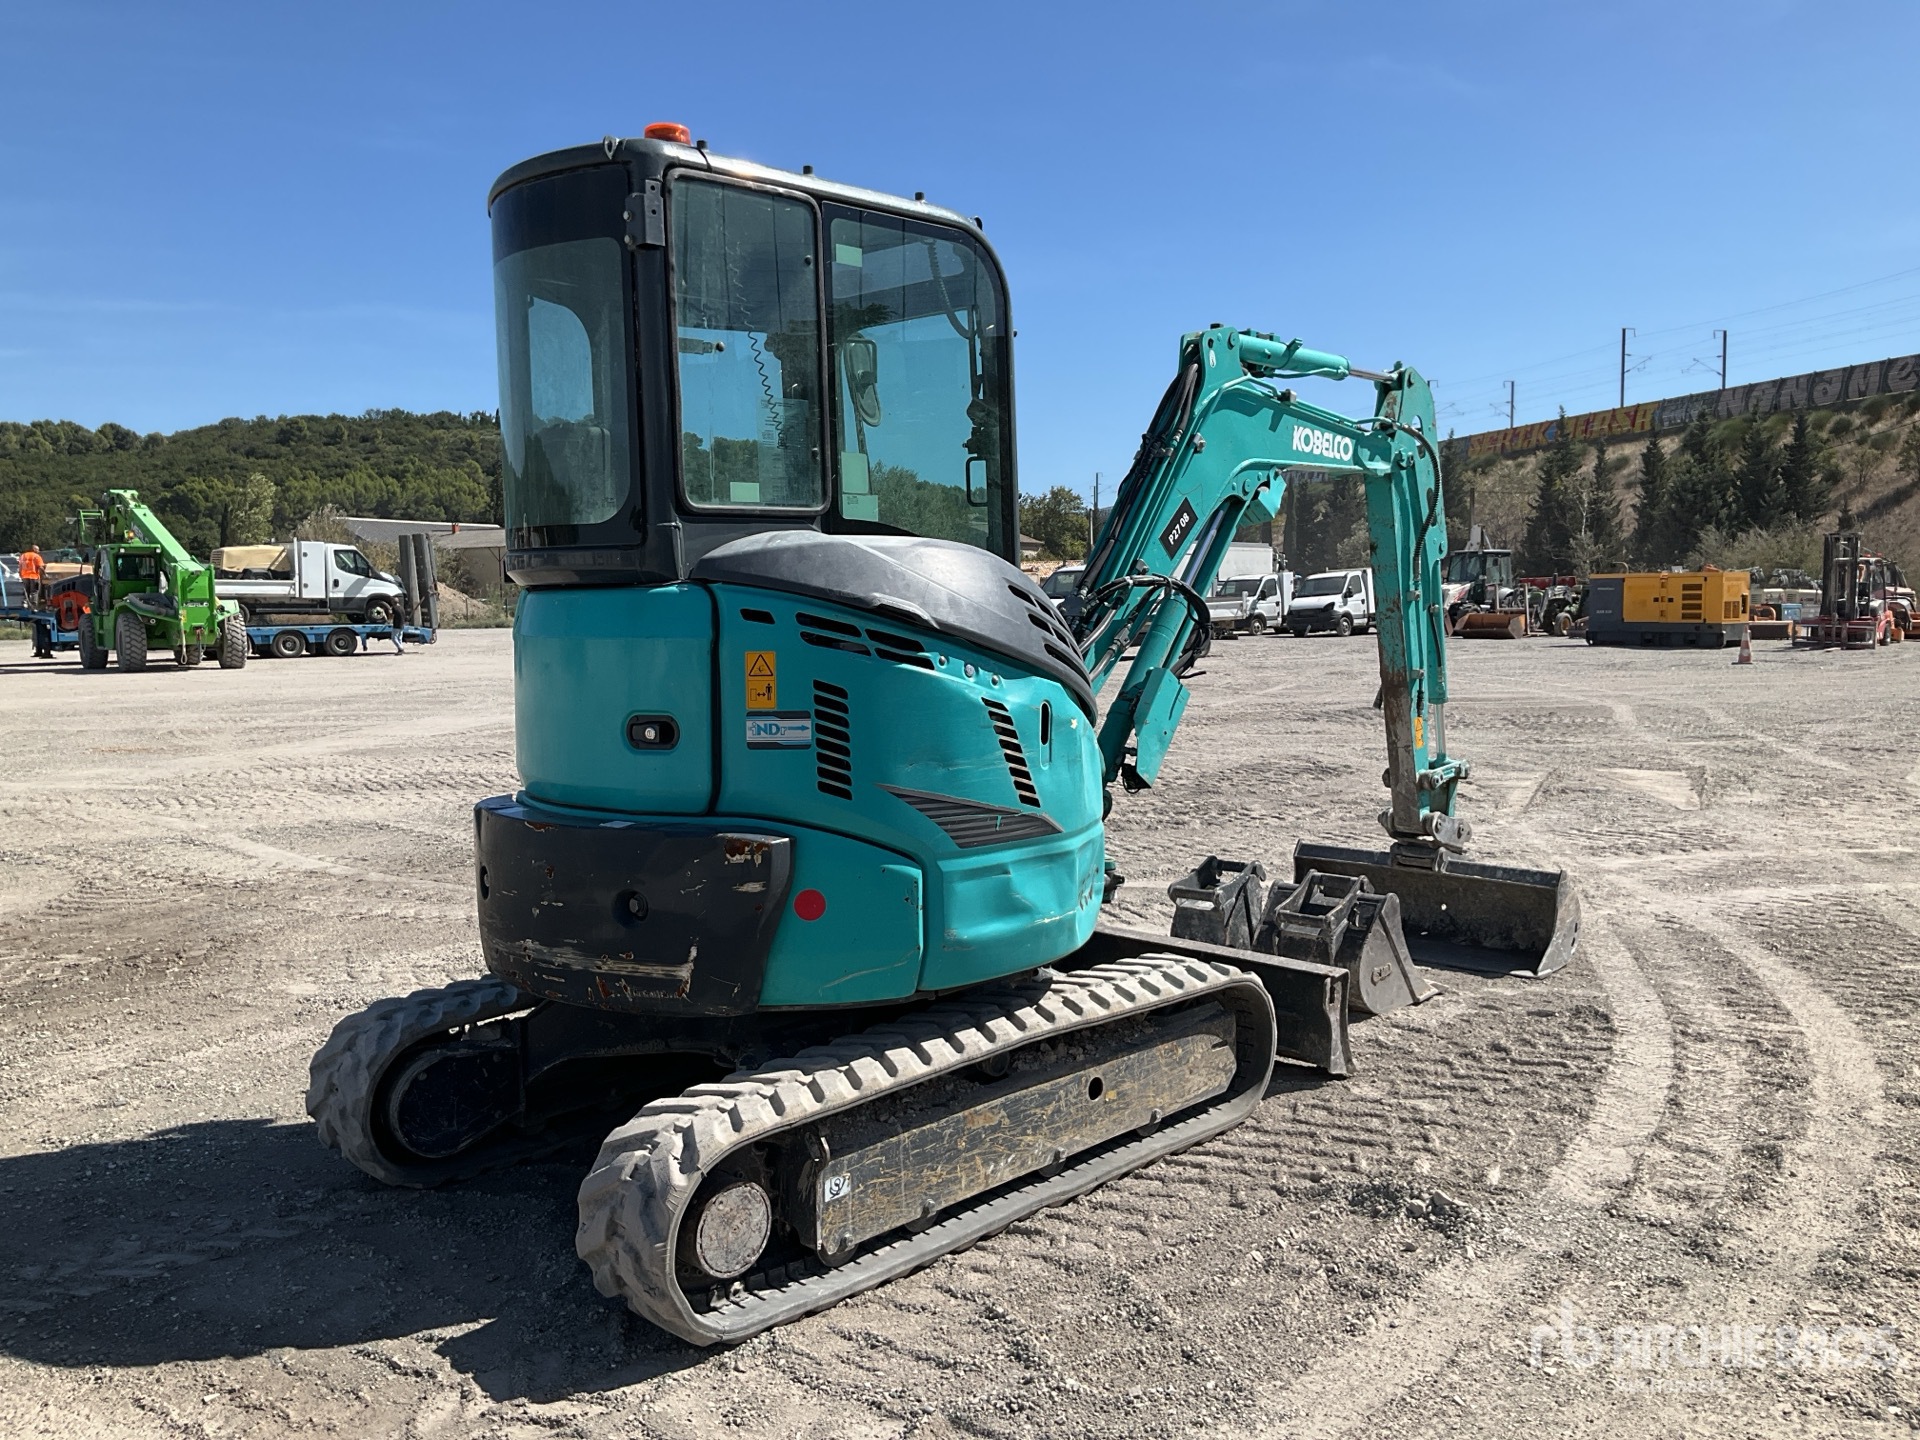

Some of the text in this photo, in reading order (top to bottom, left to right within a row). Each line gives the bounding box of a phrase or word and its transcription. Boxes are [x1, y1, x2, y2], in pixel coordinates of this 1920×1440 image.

[1292, 425, 1353, 461] KOBELCO
[1168, 512, 1191, 545] P27 08
